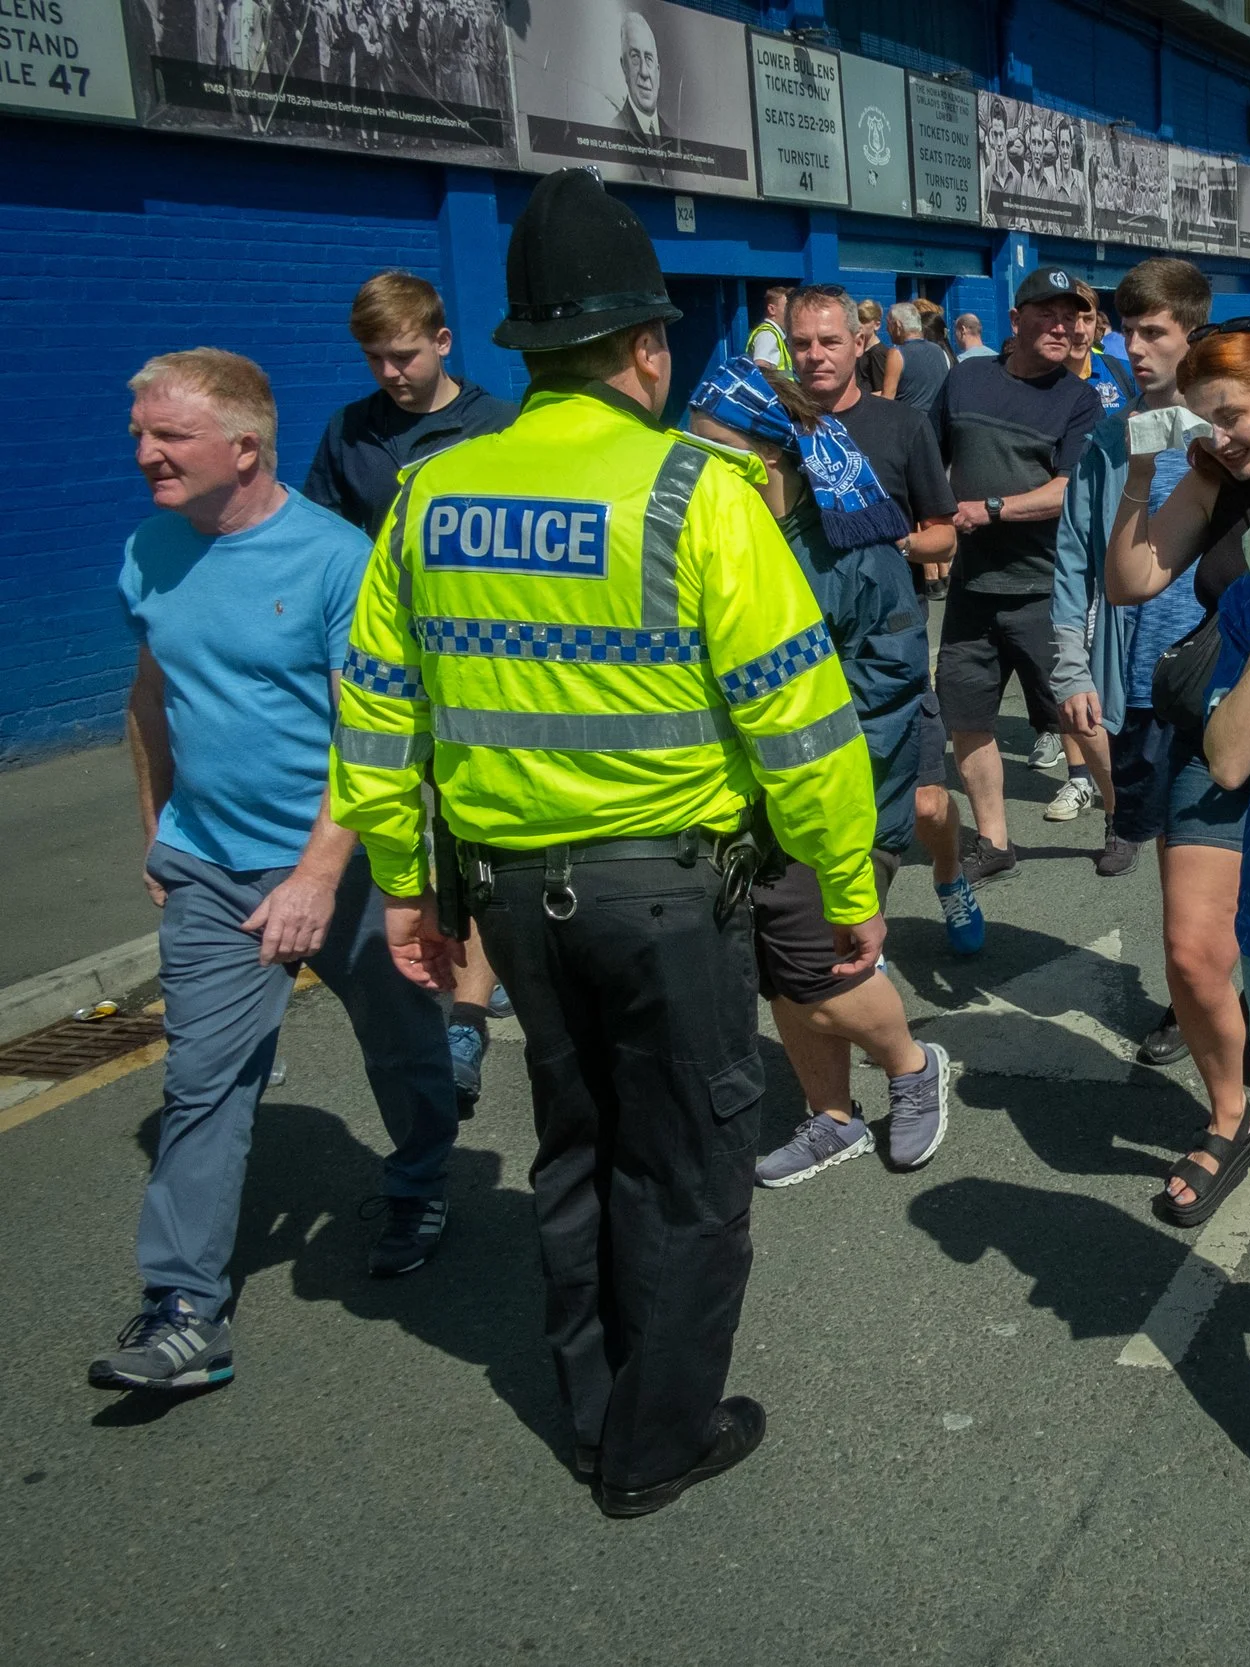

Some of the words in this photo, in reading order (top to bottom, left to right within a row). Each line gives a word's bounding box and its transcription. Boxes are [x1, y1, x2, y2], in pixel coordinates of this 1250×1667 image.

[0, 26, 79, 59] STAND
[757, 49, 791, 71] LOWER
[793, 58, 835, 81] BULLENS
[48, 64, 90, 97] 47
[765, 74, 805, 96] TICKETS
[807, 84, 830, 102] ONLY
[338, 101, 363, 114] Everton
[399, 110, 425, 122] Liverpool
[765, 108, 795, 127] SEATS
[798, 114, 836, 134] 252-298
[919, 123, 950, 142] TICKETS
[951, 131, 969, 146] ONLY
[778, 148, 830, 169] TURNSTILE
[920, 147, 943, 164] SEATS
[944, 152, 972, 170] 172-208
[799, 171, 814, 191] 41
[925, 172, 969, 192] TURNSTILES
[929, 191, 942, 209] 40
[955, 195, 968, 212] 39
[429, 505, 598, 564] POLICE
